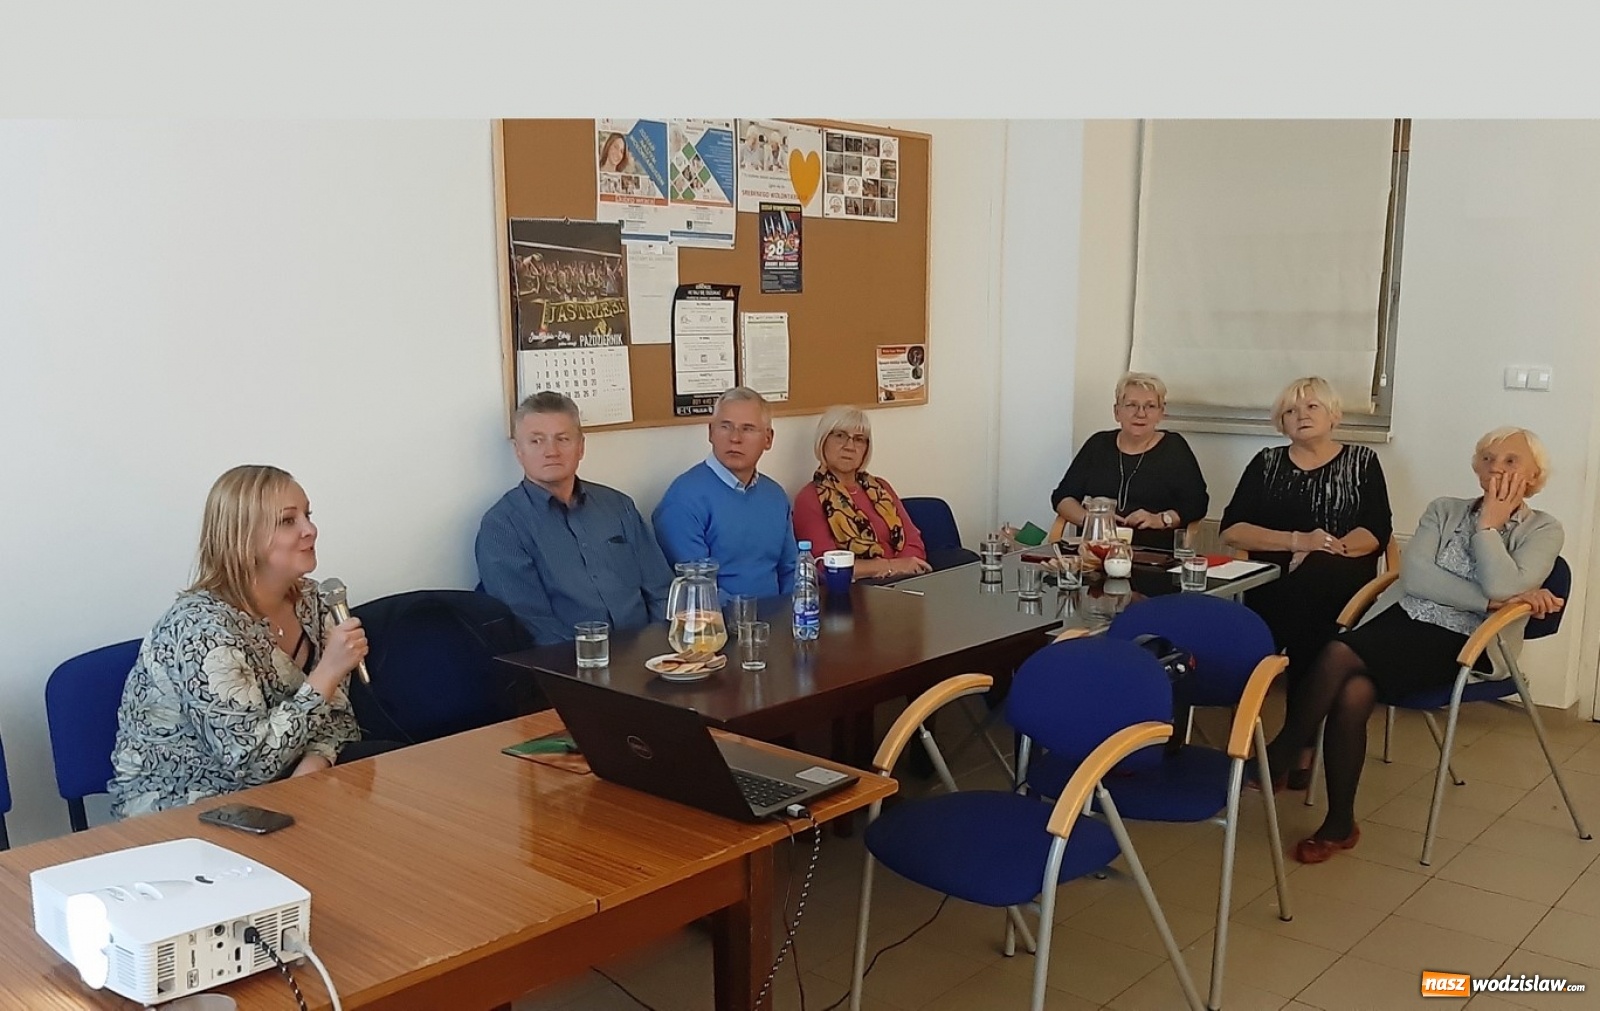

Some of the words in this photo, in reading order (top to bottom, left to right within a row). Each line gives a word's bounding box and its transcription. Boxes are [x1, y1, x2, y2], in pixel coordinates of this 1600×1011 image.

[768, 240, 784, 257] 28
[582, 368, 587, 376] 12
[583, 390, 589, 398] 26
